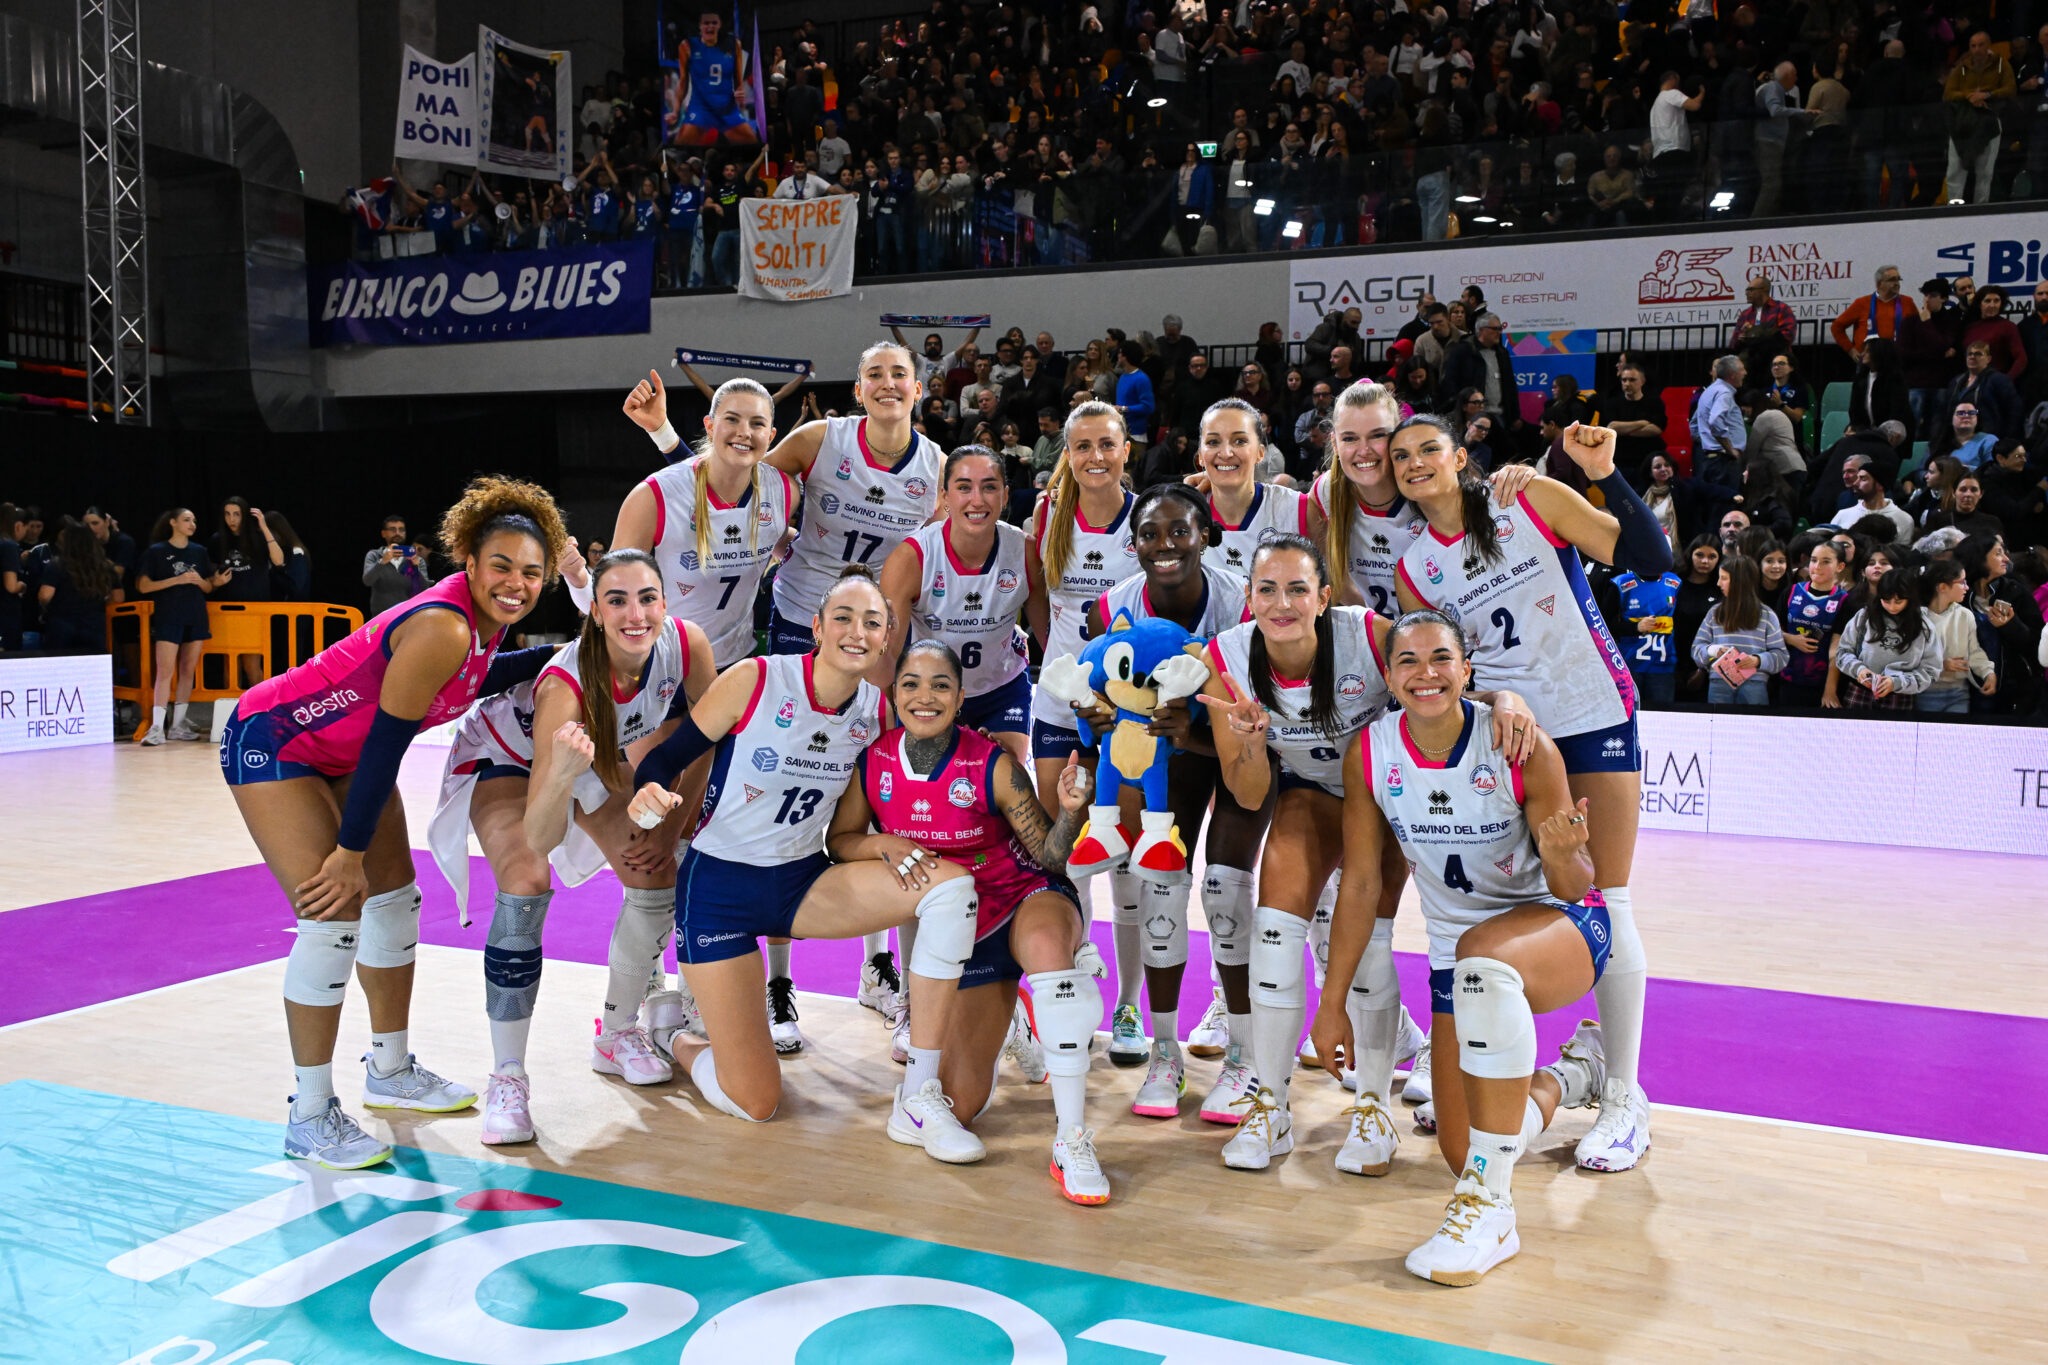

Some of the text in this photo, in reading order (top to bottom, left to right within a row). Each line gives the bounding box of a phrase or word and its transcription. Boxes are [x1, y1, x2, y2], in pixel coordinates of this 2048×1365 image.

[408, 61, 469, 88] POHI
[709, 64, 722, 85] 9
[416, 93, 459, 117] MA
[403, 117, 471, 147] BÒNI
[757, 200, 842, 231] SEMPRE
[755, 242, 827, 270] SOLITI
[1748, 242, 1821, 263] BANCA
[1988, 239, 2048, 284] Bi
[1460, 272, 1545, 285] COSTRUZIONI
[1746, 261, 1853, 283] GENERALI
[509, 260, 627, 312] BLUES
[1770, 283, 1819, 297] IVATE
[1294, 275, 1434, 317] RAGGI
[1502, 292, 1577, 304] E RESTAURI
[1638, 303, 1851, 324] WEALTH MAEMENT
[697, 355, 724, 363] SAVINO
[762, 361, 790, 369] VOLLEY
[1514, 373, 1548, 385] ST 2
[865, 495, 884, 505] errea
[844, 503, 876, 518] SAVINO
[878, 513, 895, 522] DEL
[724, 537, 741, 545] errea
[842, 529, 884, 563] 17
[706, 551, 737, 561] AVINO
[1371, 546, 1391, 554] errea
[1083, 562, 1103, 571] errea
[1356, 558, 1388, 570] SAVINO
[1466, 564, 1486, 581] errea
[1063, 576, 1097, 586] SAVINO
[1457, 556, 1540, 607] SAVINO DEL BENE
[716, 576, 740, 610] 7
[964, 603, 982, 612] errea
[947, 618, 978, 626] SAVINO
[982, 617, 997, 626] DEL
[1491, 607, 1521, 650] 2
[961, 641, 983, 668] 6
[1636, 634, 1667, 662] 24
[26, 686, 85, 717] FILM
[28, 717, 85, 738] FIRENZE
[624, 722, 643, 736] errea
[1281, 726, 1322, 736] SAVINO
[807, 744, 827, 754] errea
[785, 756, 856, 772] SAVINO DEL BE
[1645, 749, 1704, 788] LM
[774, 786, 824, 825] 13
[1429, 806, 1453, 815] errea
[911, 813, 932, 822] errea
[893, 826, 984, 840] SAVINO DEL BENE
[1410, 819, 1511, 834] SAVINO DEL BENE
[1444, 854, 1474, 894] 4
[1262, 938, 1281, 946] errea
[964, 967, 995, 975] lanum
[1463, 986, 1484, 994] errea
